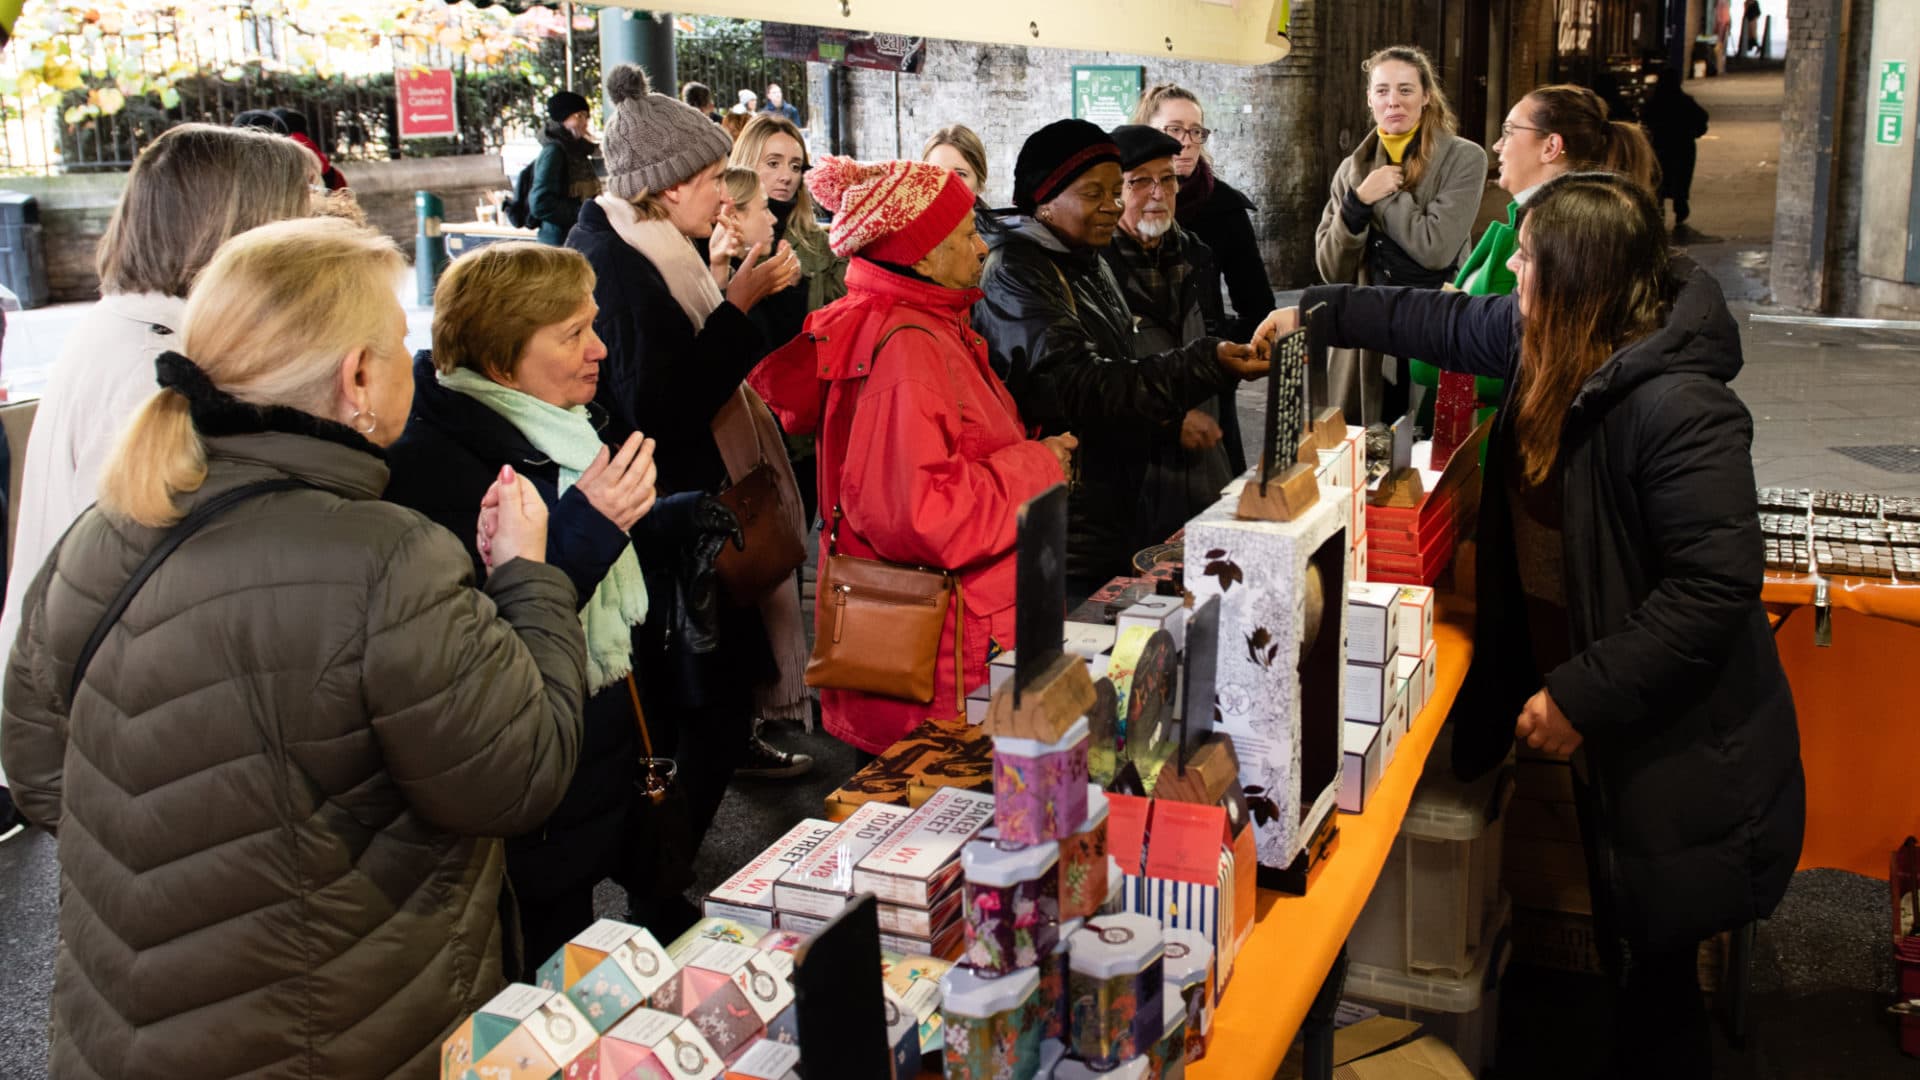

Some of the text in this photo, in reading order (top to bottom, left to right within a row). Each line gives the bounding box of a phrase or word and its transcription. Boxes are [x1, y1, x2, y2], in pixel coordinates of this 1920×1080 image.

[1883, 117, 1896, 140] E
[854, 811, 897, 839] ROAD
[923, 797, 973, 835] STREET
[948, 800, 995, 835] BAKER
[870, 814, 926, 859] WESTMINSTER
[722, 846, 783, 890] WESTMINSTER
[740, 829, 831, 895] STREET W1
[889, 846, 922, 864] W1
